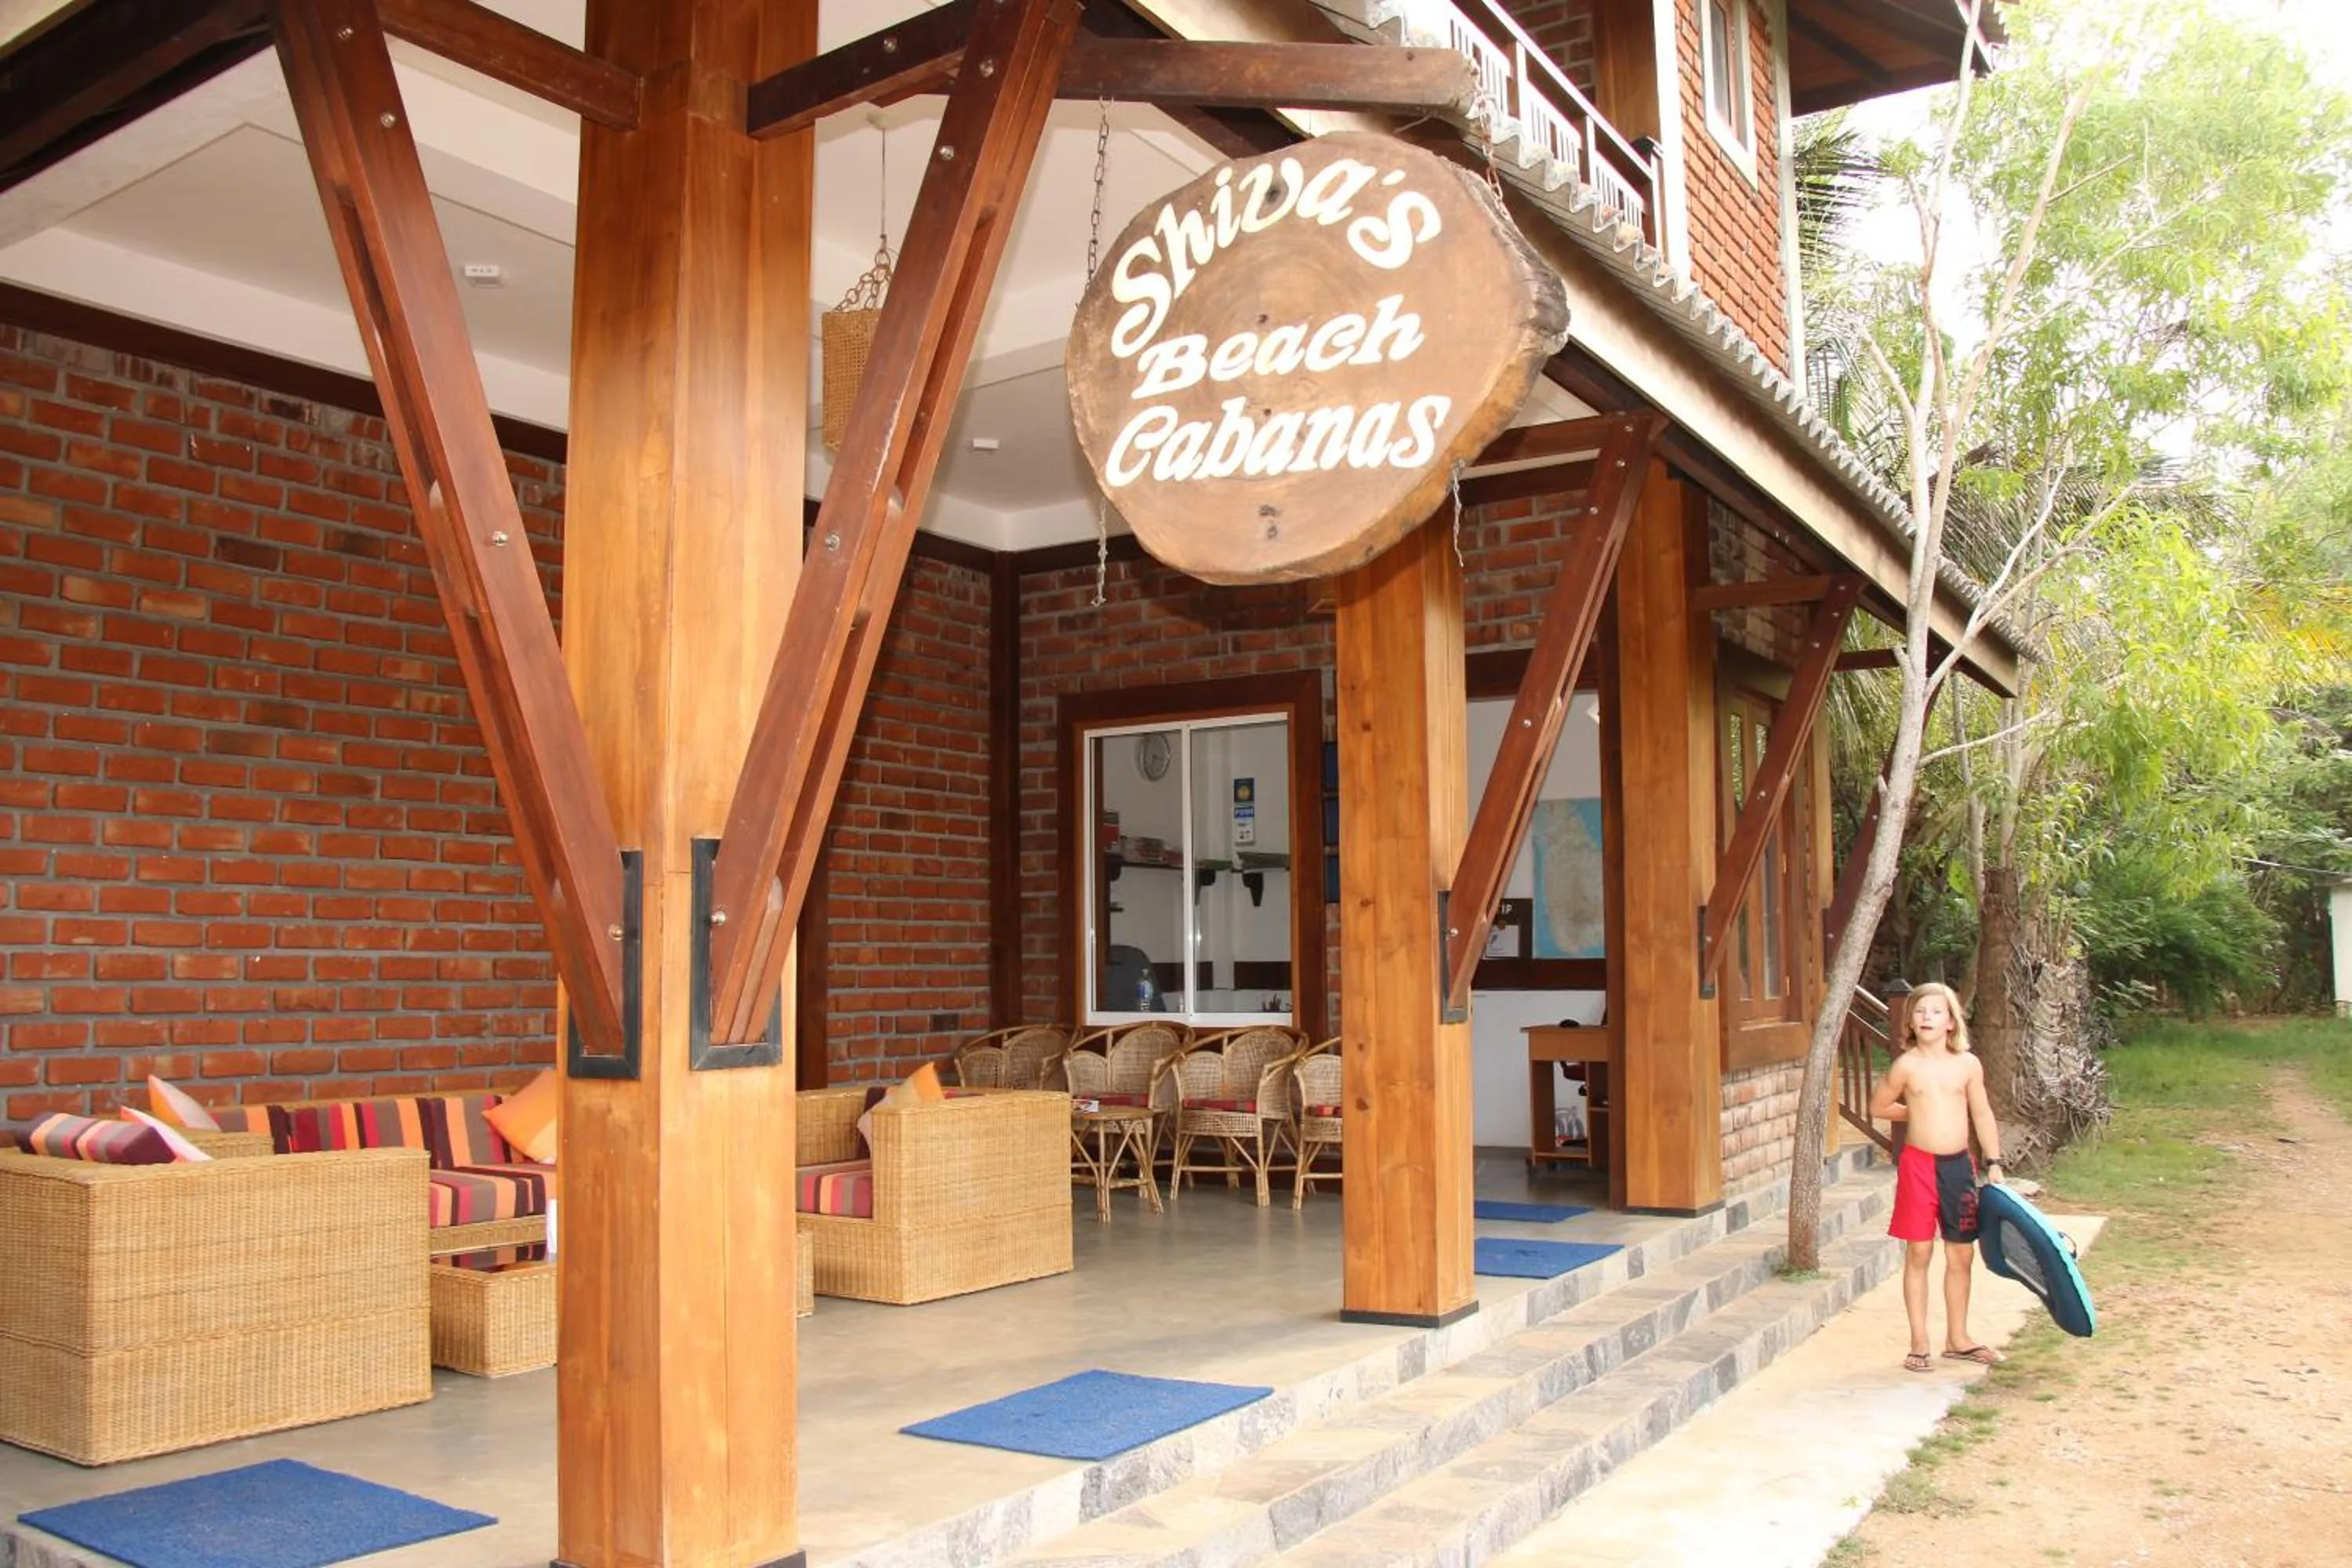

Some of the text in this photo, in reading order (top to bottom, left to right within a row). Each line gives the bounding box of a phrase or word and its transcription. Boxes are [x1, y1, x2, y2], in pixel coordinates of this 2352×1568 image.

[1111, 158, 1442, 358] Shiva's
[1131, 293, 1425, 399] Beach
[1105, 394, 1452, 487] Cabanas
